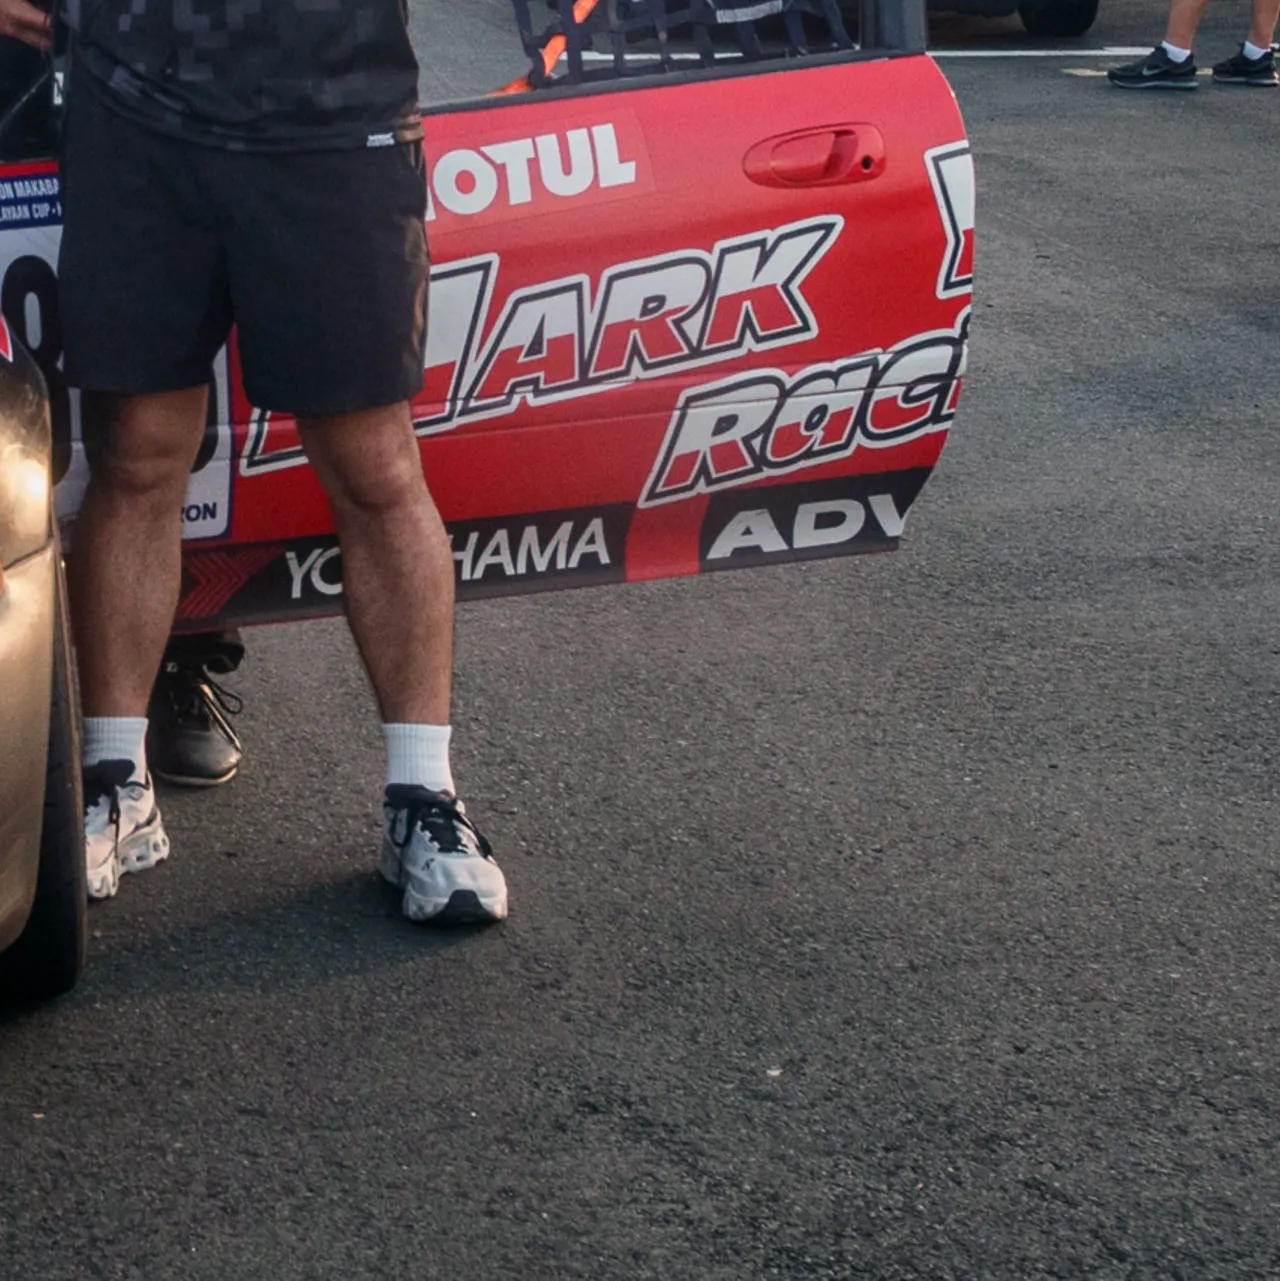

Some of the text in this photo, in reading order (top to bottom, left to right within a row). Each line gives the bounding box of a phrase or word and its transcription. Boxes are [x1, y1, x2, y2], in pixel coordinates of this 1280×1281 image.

[31, 203, 50, 219] CUP
[423, 122, 637, 221] OTUL
[285, 518, 611, 600] YOHAMA
